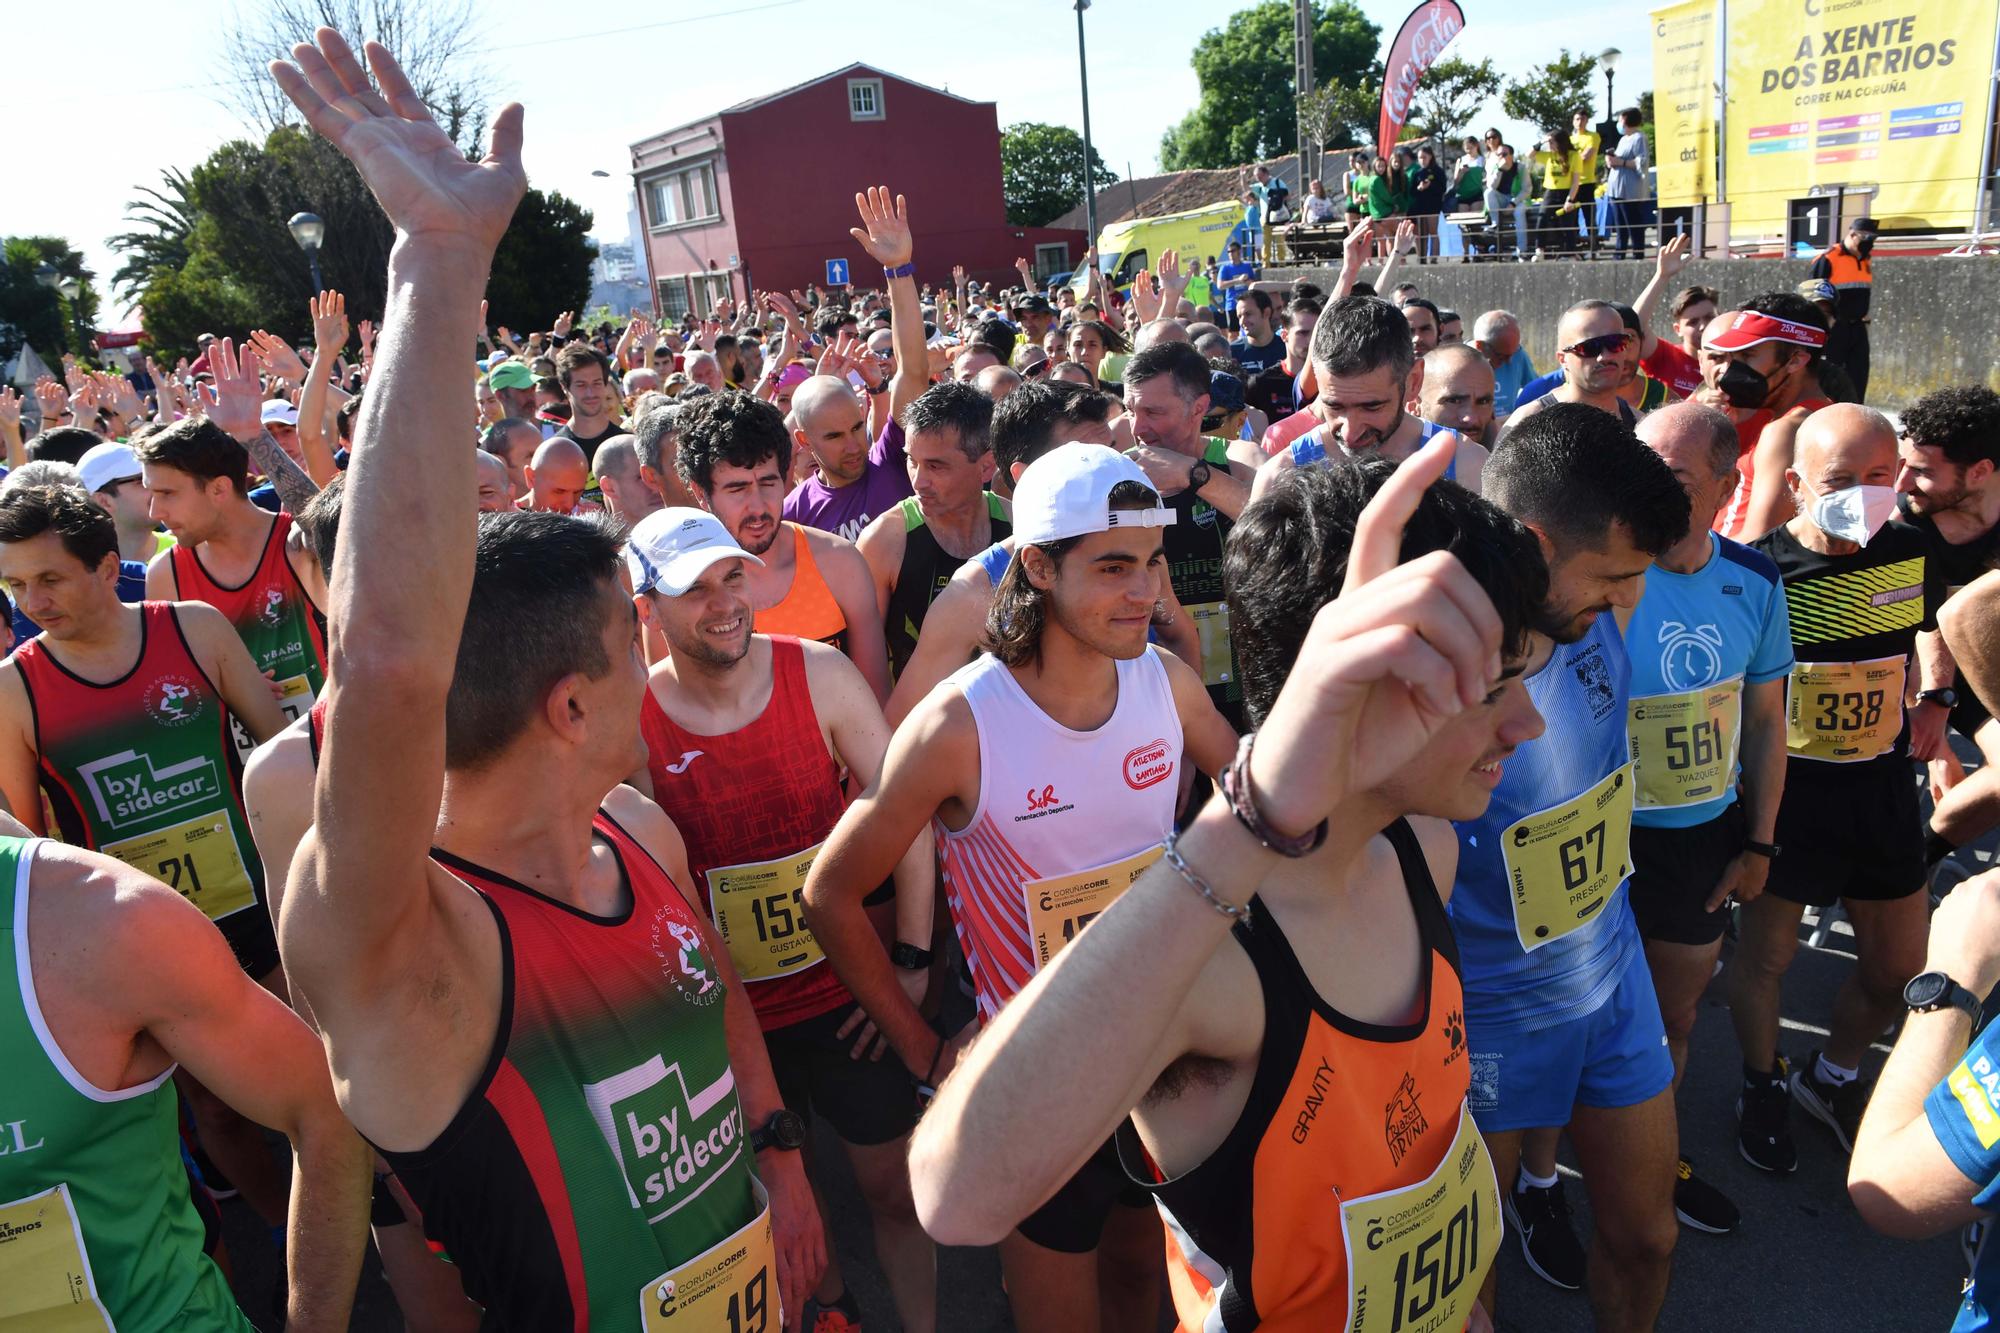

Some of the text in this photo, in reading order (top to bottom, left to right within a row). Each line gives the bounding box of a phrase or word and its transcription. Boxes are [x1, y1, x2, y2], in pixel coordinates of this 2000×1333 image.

[1794, 15, 1916, 61] A XENTE
[1761, 39, 1957, 93] DOS BARRIOS
[1795, 80, 1906, 106] CORRE NA CORUÑA
[1566, 642, 1602, 667] MARINEDA
[1815, 689, 1884, 730] 338
[1665, 717, 1722, 771] 561
[1816, 734, 1845, 744] JULIO
[1132, 748, 1165, 768] ATLETISMO
[1135, 763, 1166, 781] SANTIAGO
[103, 773, 142, 796] by
[1675, 767, 1720, 784] JVAZQUEZ
[1014, 803, 1074, 822] Orientación Deportiva
[1559, 819, 1606, 891] 67
[1053, 878, 1109, 897] CORUÑACORRE
[1513, 866, 1525, 898] TANDA
[1569, 874, 1609, 905] PRESEDO
[1061, 898, 1084, 907] EDICIÓN
[718, 910, 727, 938] TANDA
[770, 935, 813, 954] GUSTAVO
[1291, 1055, 1335, 1144] GRAVITY
[626, 1106, 677, 1158] by
[1387, 1183, 1447, 1226] CORUÑACORRE
[1393, 1221, 1421, 1240] EDICIÓN
[678, 1247, 748, 1294] CORUÑACORRE
[1391, 1189, 1478, 1333] 1501
[680, 1301, 687, 1309] IX
[688, 1283, 716, 1304] EDICIÓN
[726, 1264, 767, 1333] 19
